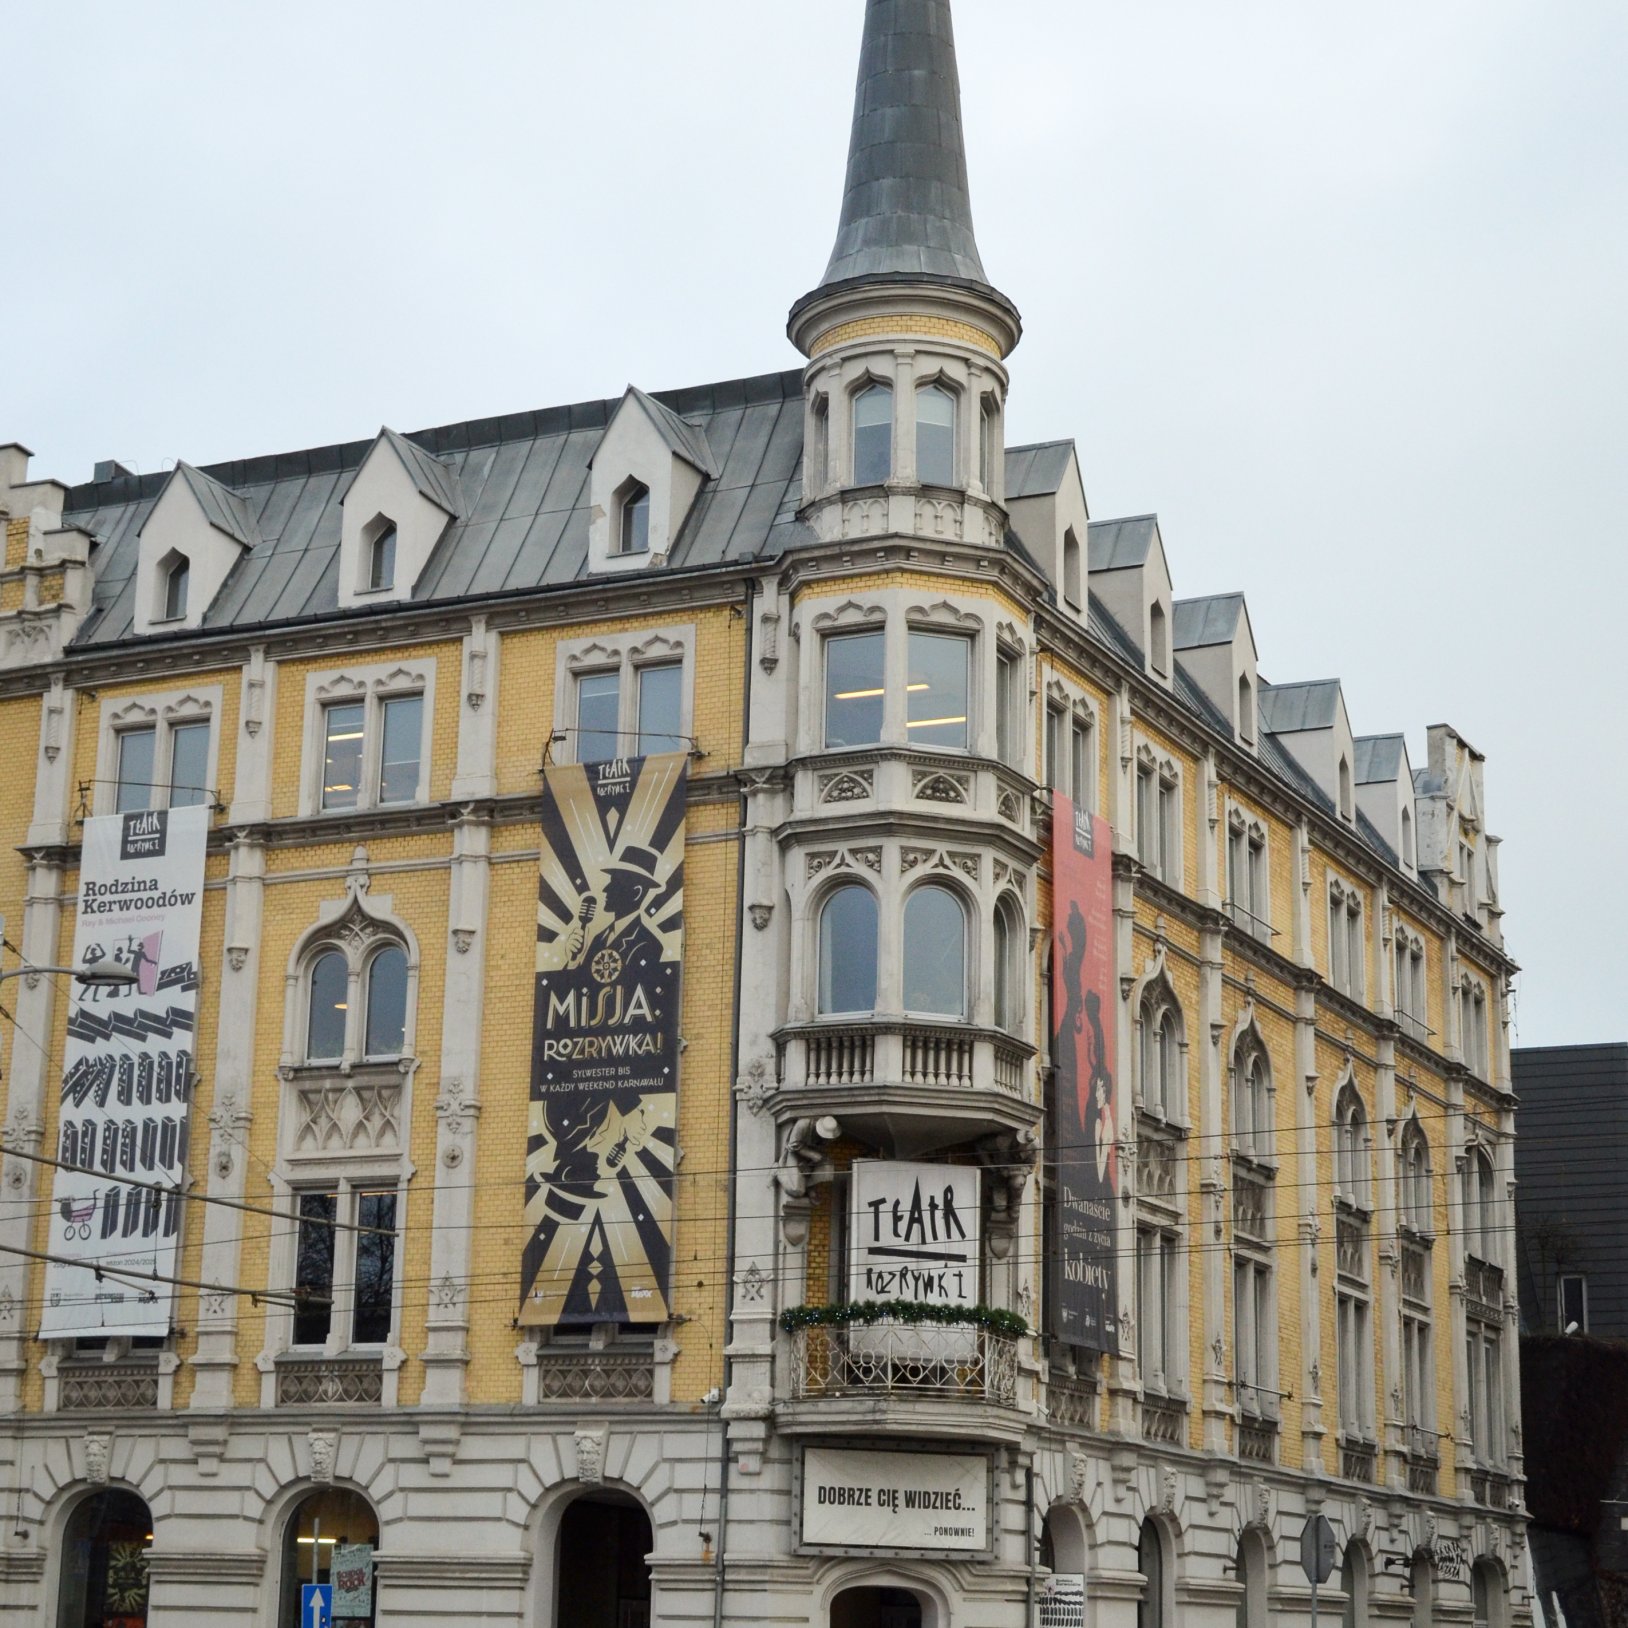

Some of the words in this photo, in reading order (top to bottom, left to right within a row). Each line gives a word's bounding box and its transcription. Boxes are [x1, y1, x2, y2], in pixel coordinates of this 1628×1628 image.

[83, 876, 159, 898] Rodzina
[81, 889, 196, 915] Kerwoodów
[544, 1032, 664, 1062] ROZRYWKA!
[540, 1084, 548, 1093] W
[550, 1083, 575, 1092] KAŻDY
[578, 1080, 615, 1090] WEEKEND
[618, 1078, 664, 1087] KARNAWAŁU
[573, 1067, 615, 1078] SYLWESTER
[618, 1066, 631, 1075] BIS
[1064, 1186, 1111, 1221] Dwanaście
[866, 1266, 967, 1300] ROZRYWKI
[1064, 1248, 1111, 1299] kobiety
[818, 1485, 872, 1506] DOBRZE
[877, 1488, 899, 1513] CIĘ
[904, 1488, 976, 1511] WIDZIEĆ...
[934, 1526, 975, 1537] PONOWNIE!
